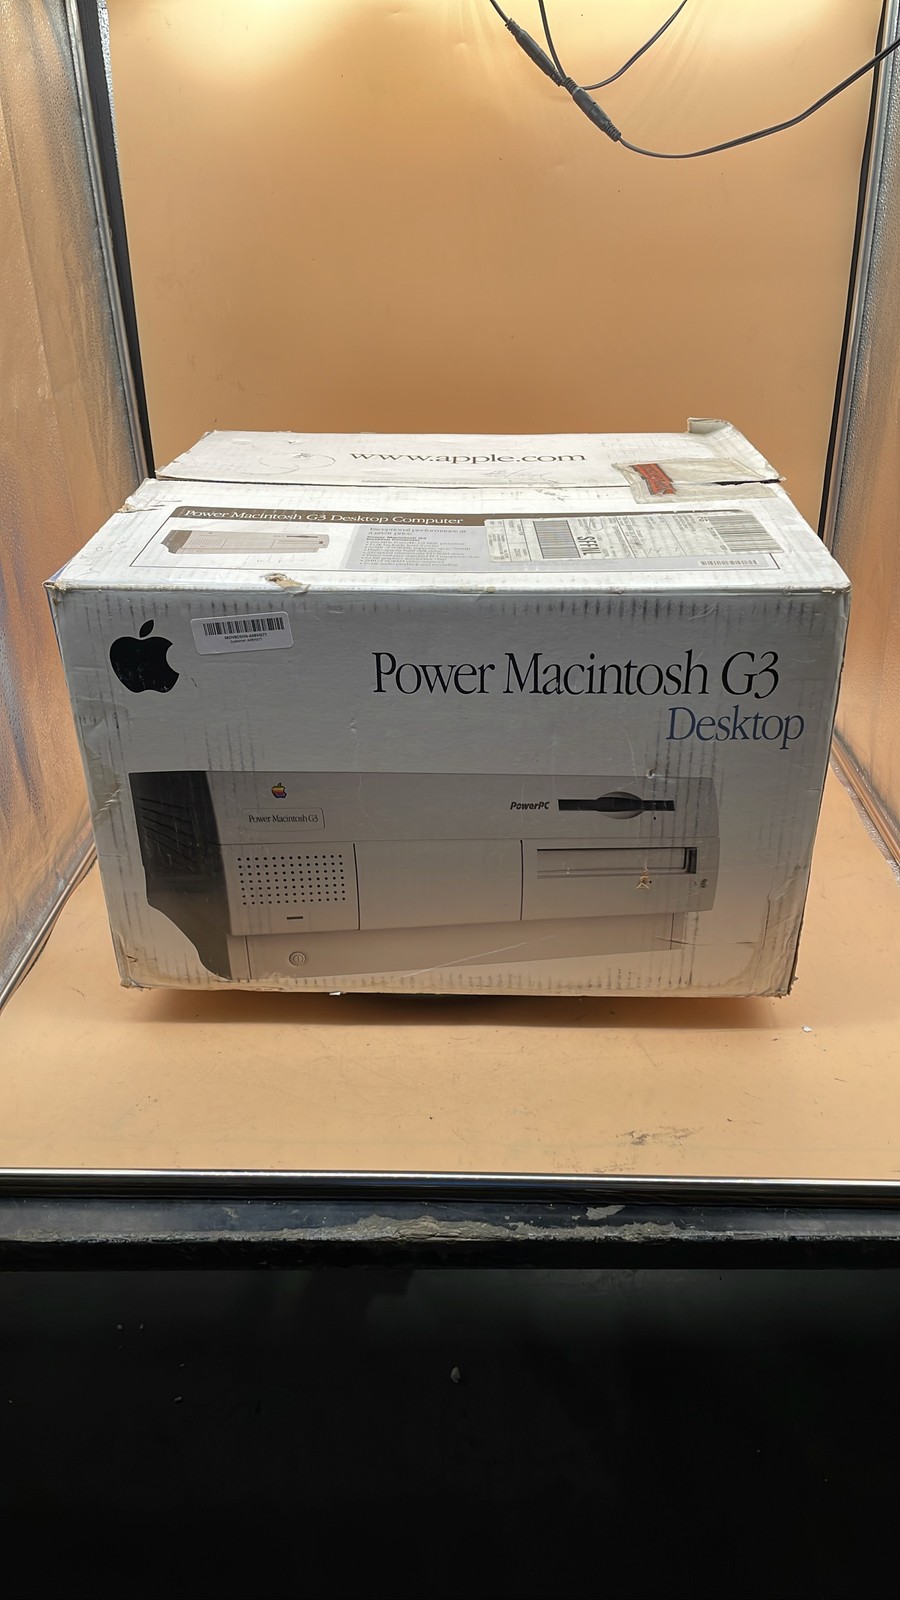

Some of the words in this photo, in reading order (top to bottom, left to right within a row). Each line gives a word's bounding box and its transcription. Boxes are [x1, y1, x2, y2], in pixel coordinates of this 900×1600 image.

[349, 452, 587, 465] www.apple.com
[184, 509, 229, 518] Power
[230, 510, 302, 520] Macintosh
[306, 513, 327, 521] G3
[330, 514, 389, 524] Desktop
[392, 515, 464, 525] Computer
[371, 651, 496, 695] Power
[502, 648, 710, 697] Macintosh
[720, 650, 781, 699] G3
[665, 704, 805, 750] Desktop
[510, 800, 550, 811] PowerPC
[248, 814, 271, 823] Power
[271, 814, 308, 823] Macintosh
[308, 814, 319, 823] G3
